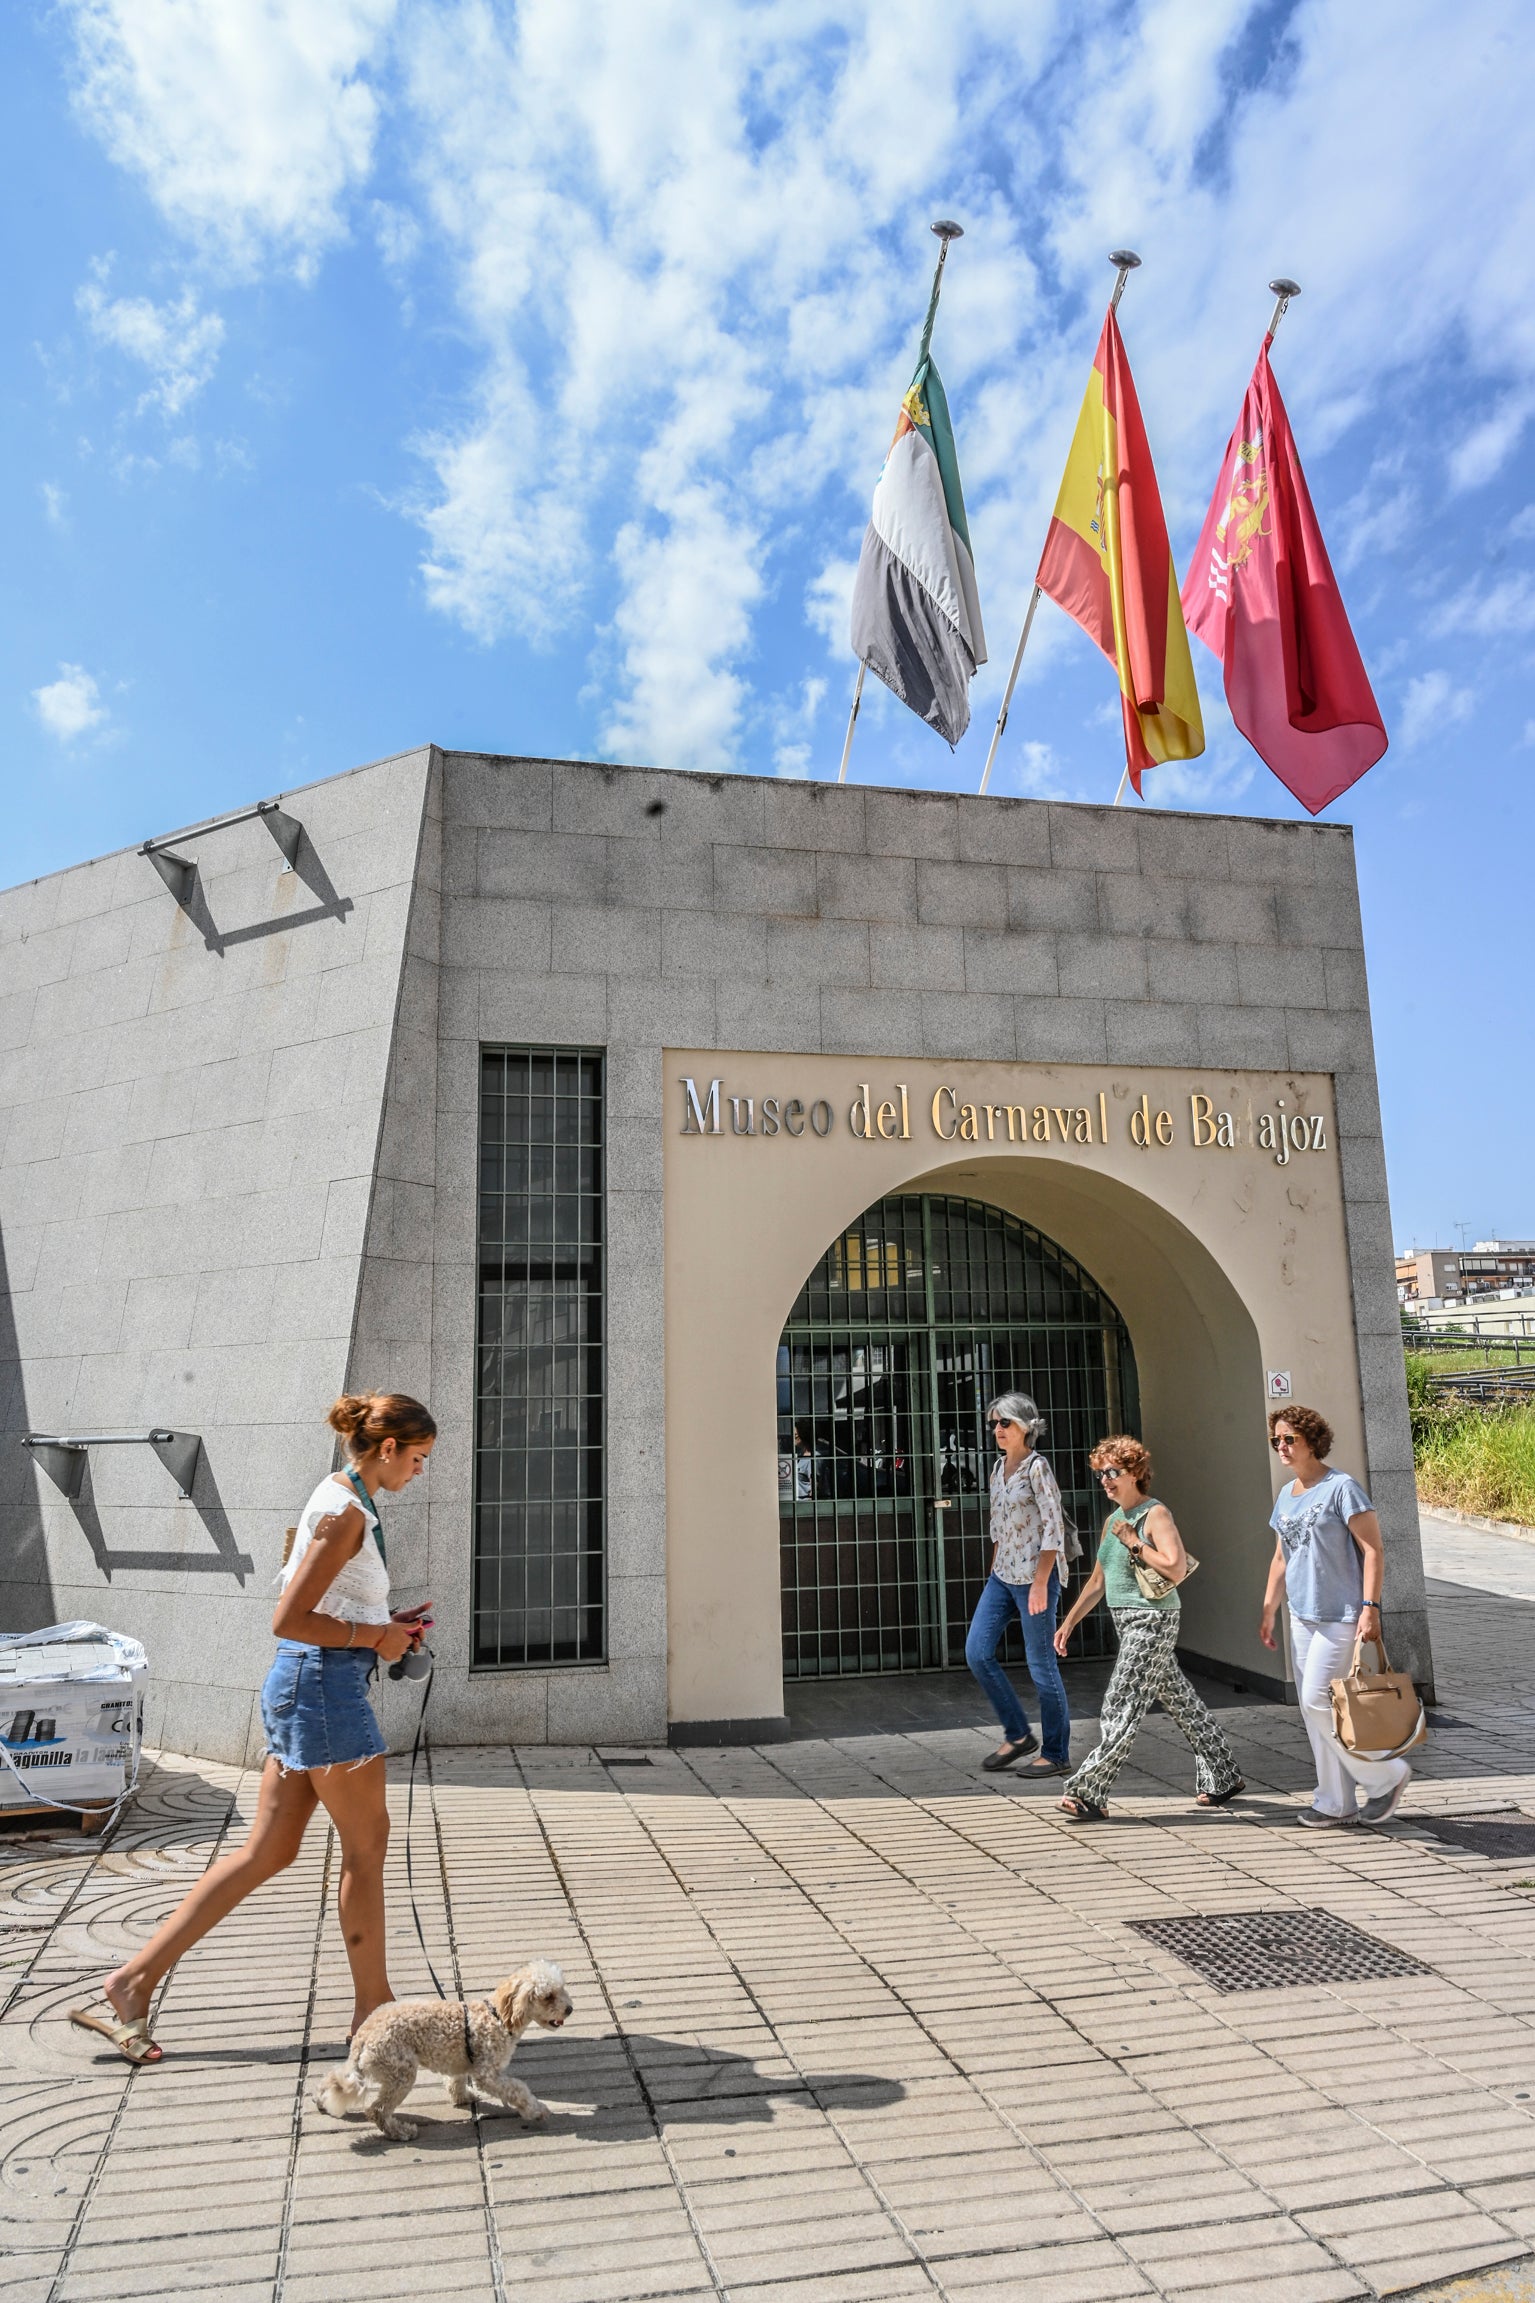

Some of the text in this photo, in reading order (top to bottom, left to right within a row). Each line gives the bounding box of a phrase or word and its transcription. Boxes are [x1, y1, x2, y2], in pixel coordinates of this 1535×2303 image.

[679, 1078, 834, 1137] Museo
[849, 1083, 914, 1139] del
[931, 1086, 1108, 1144] Carnaval
[1130, 1094, 1174, 1147] de
